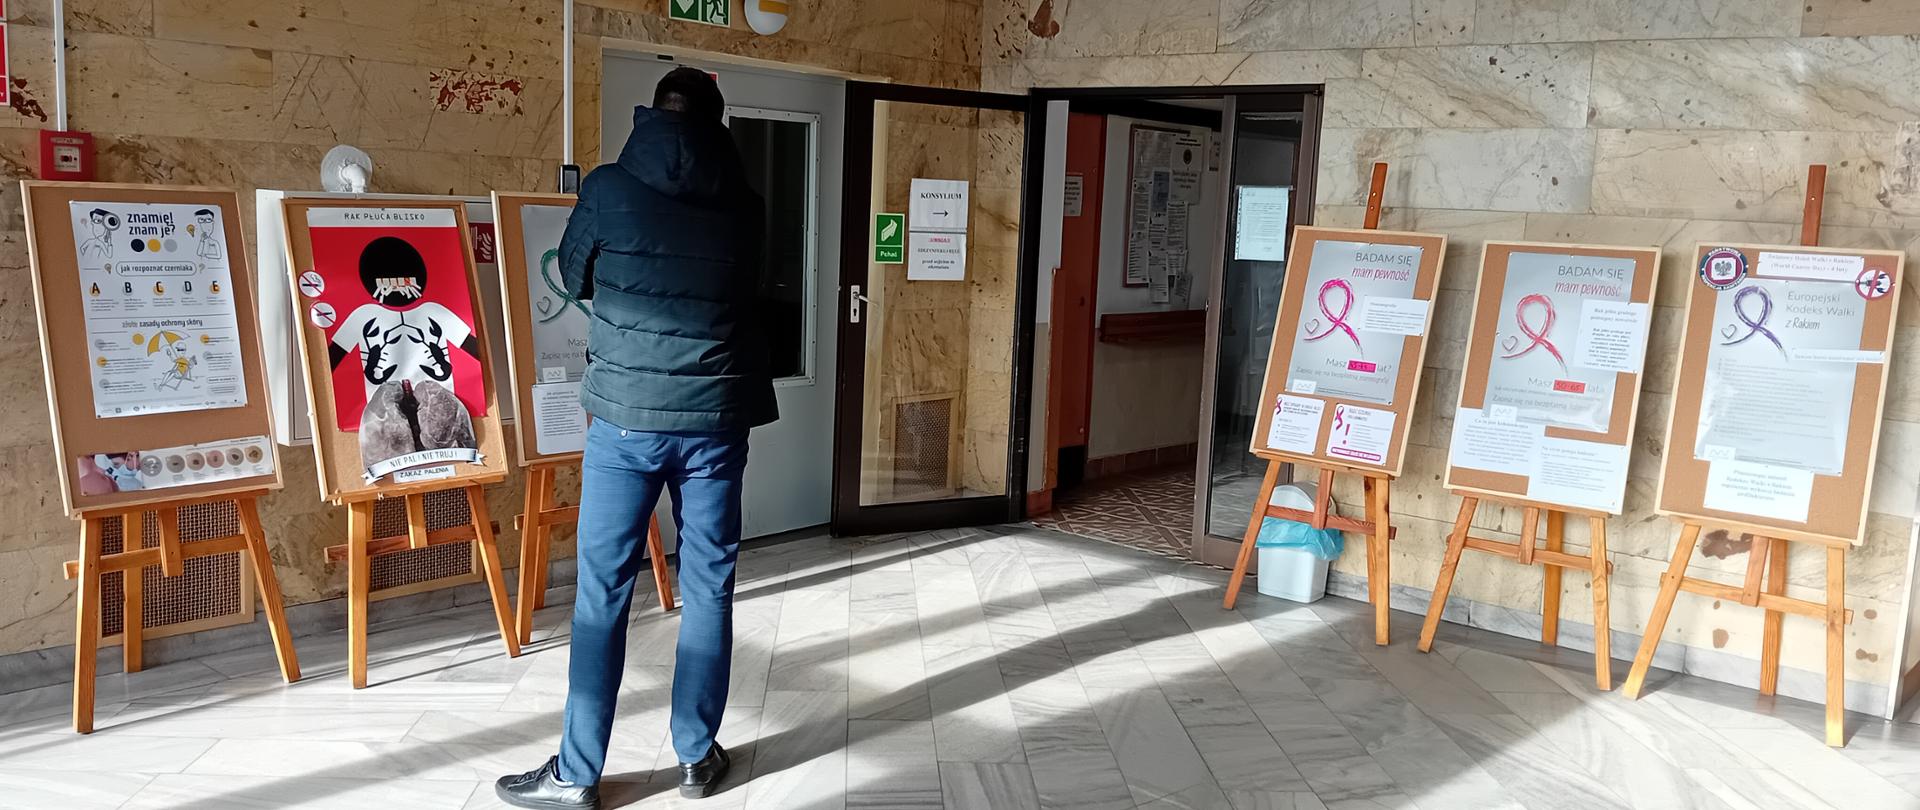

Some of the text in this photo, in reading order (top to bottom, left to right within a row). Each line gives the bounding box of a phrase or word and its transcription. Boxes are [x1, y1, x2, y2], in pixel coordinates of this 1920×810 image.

[921, 192, 962, 200] KONSYLIUM
[127, 211, 174, 227] znamię!
[344, 212, 425, 222] RAK PŁUCA BLISKO
[129, 224, 176, 239] znam je?
[1355, 252, 1412, 267] BADAM SIĘ
[120, 264, 131, 274] jak
[164, 264, 193, 272] czerniaka
[1352, 267, 1410, 281] mam pewność
[1558, 265, 1624, 282] BADAM SIĘ
[91, 282, 101, 294] A
[124, 282, 132, 293] B
[155, 281, 163, 293] C
[184, 281, 192, 292] D
[212, 281, 220, 292] E
[1554, 281, 1579, 293] mam
[1788, 292, 1840, 304] Europejski
[1785, 304, 1855, 317] Kodeks Walki
[139, 320, 161, 329] zasady
[161, 319, 186, 328] ochrony
[186, 318, 203, 327] skóry
[1785, 318, 1820, 330] z Rakiem
[567, 338, 588, 347] Masz
[1326, 358, 1347, 367] Masz
[1528, 377, 1552, 387] Masz
[390, 459, 401, 467] NIE
[403, 455, 416, 465] PAL
[422, 453, 433, 461] NIE
[435, 451, 454, 460] TRUJ
[400, 466, 449, 478] ZAKAZ PALENIA
